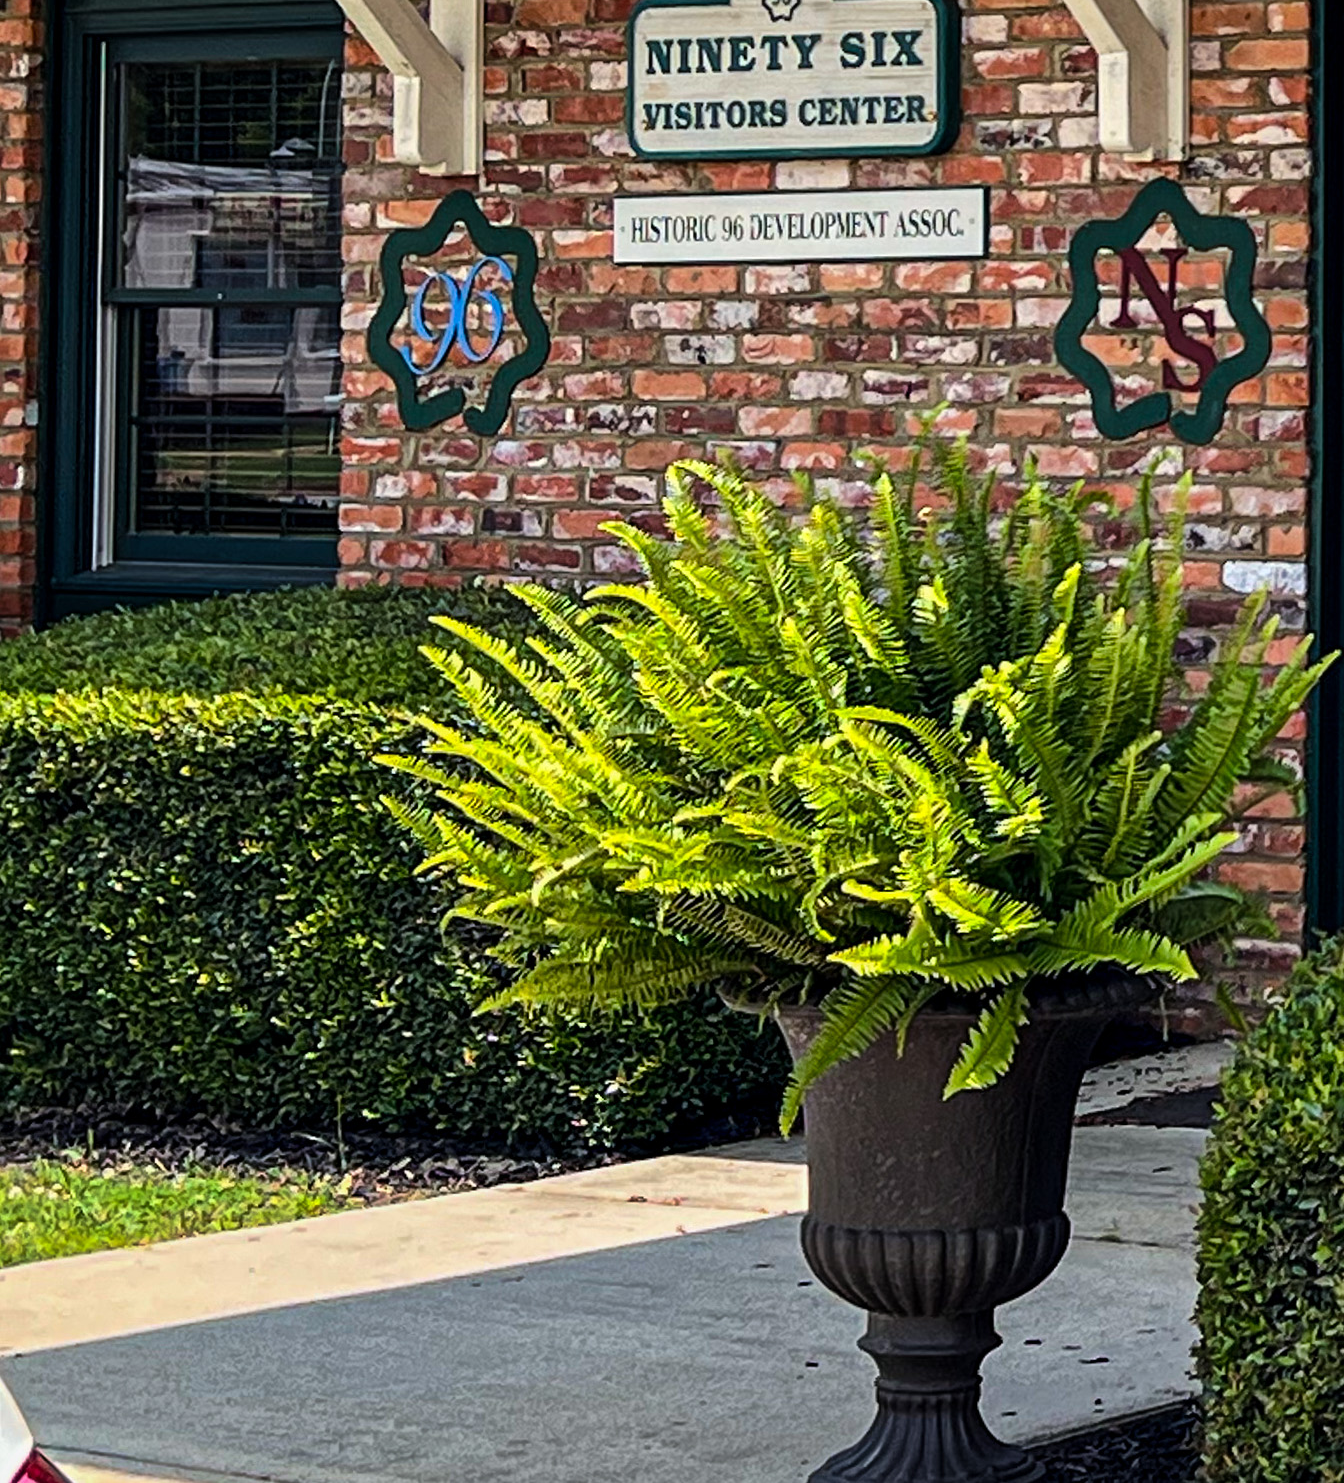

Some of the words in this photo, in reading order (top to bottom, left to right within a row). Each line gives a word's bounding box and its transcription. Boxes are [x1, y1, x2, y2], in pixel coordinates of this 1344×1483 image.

[645, 33, 823, 75] NINETY
[839, 29, 924, 69] SIX
[643, 99, 788, 131] VISITORS
[798, 94, 930, 127] CENTER
[630, 213, 718, 244] HISTORIC
[721, 218, 744, 243] 96
[749, 209, 889, 242] DEVELOPMENT
[893, 207, 966, 238] ASSOC.
[400, 255, 514, 376] 96
